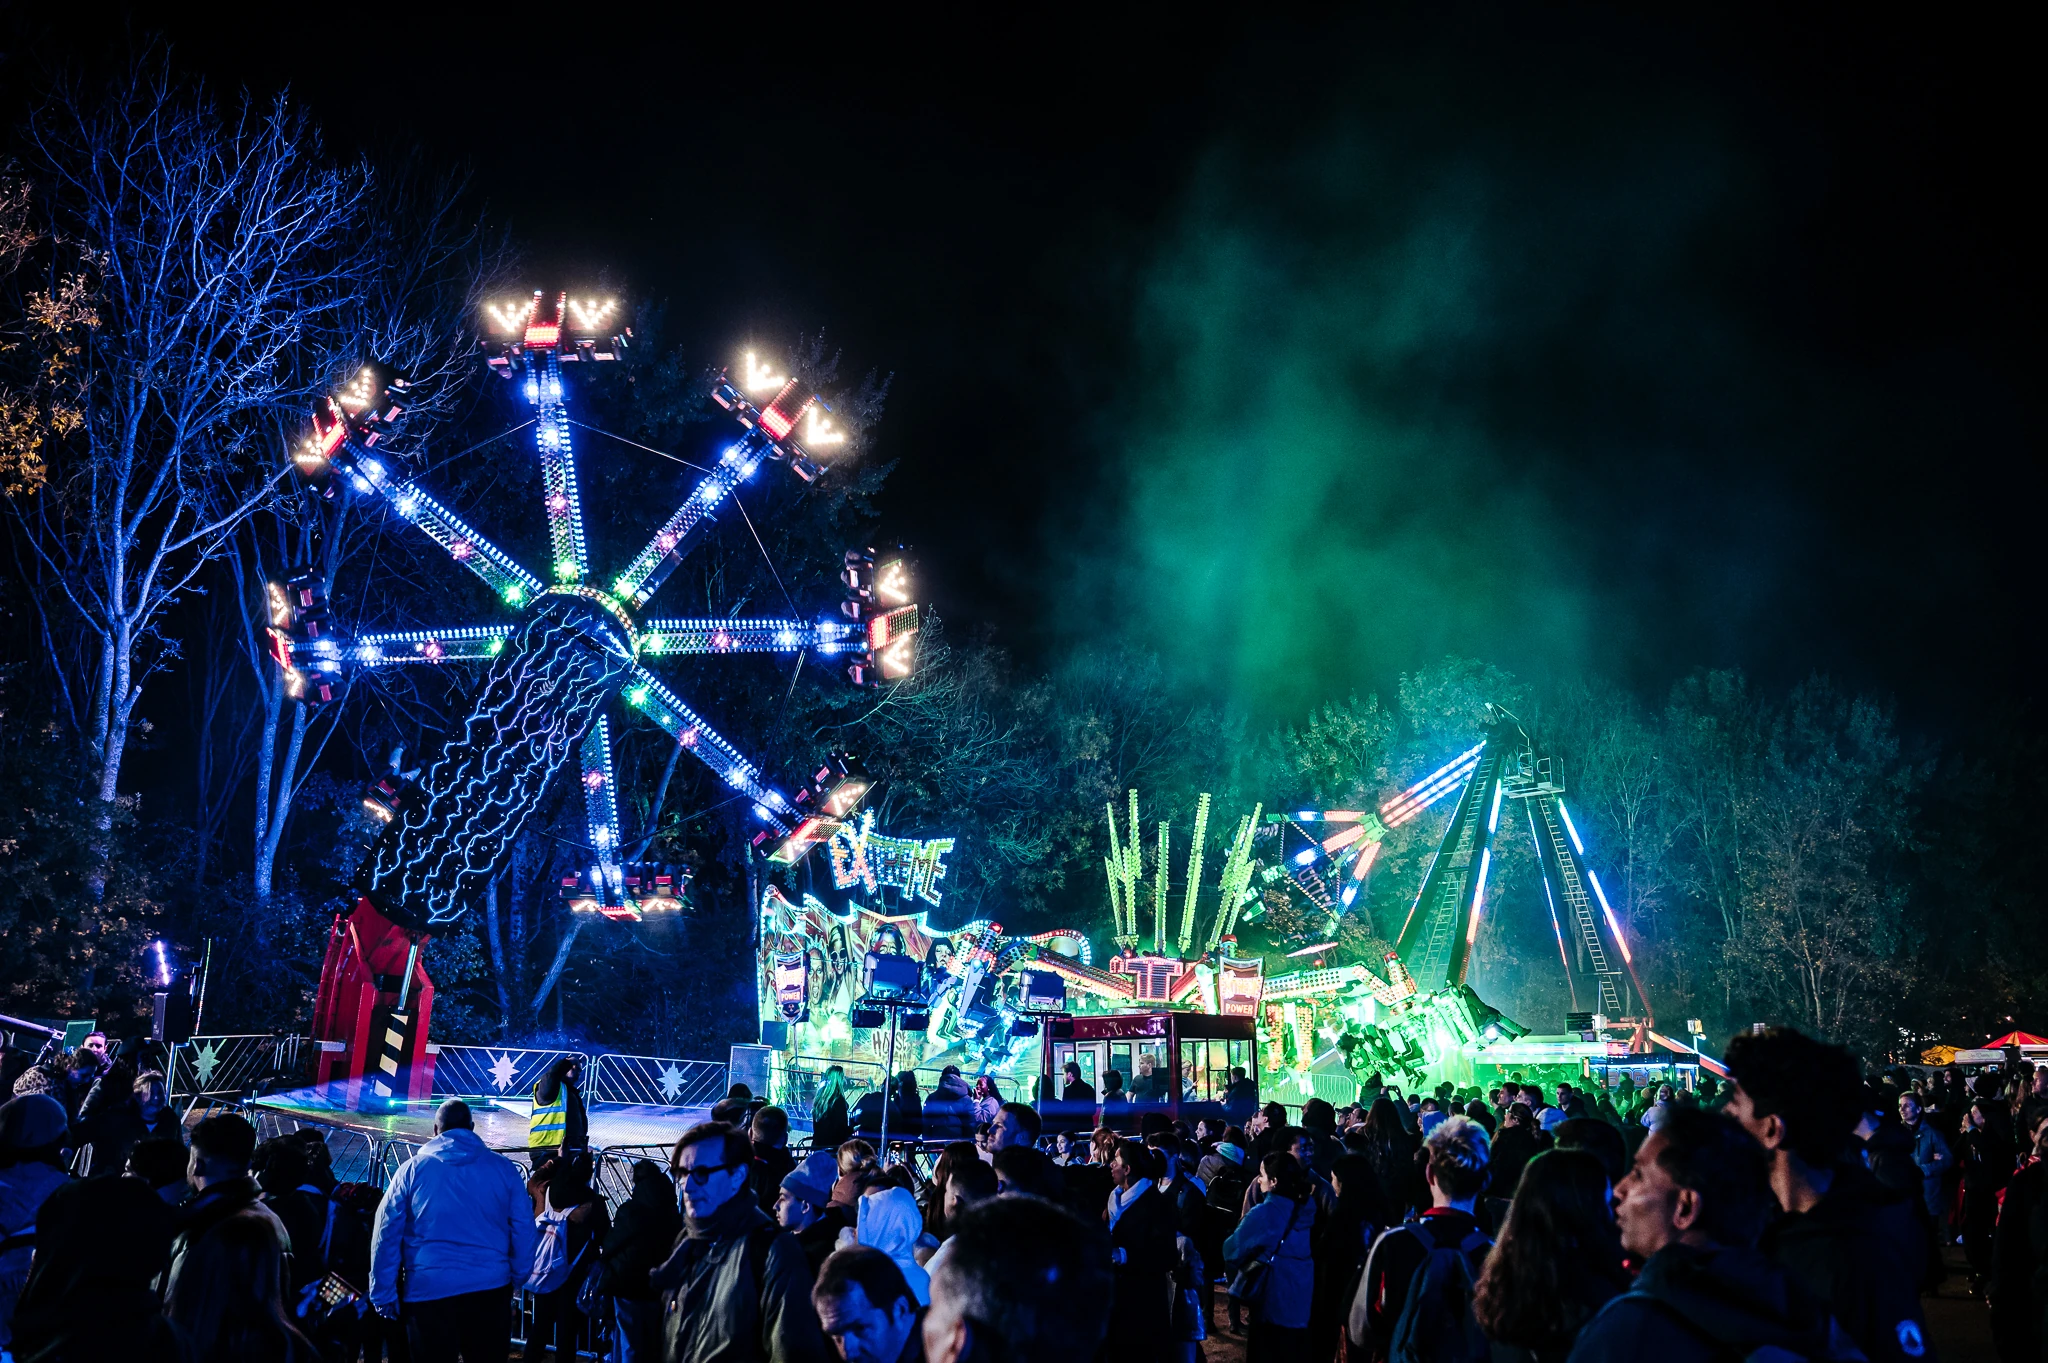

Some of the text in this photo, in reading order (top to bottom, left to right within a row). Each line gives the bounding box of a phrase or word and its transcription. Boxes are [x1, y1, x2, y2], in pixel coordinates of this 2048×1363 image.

[828, 806, 955, 907] EXTREME
[781, 991, 801, 1002] POWER
[1225, 1003, 1254, 1015] POWER
[872, 1030, 907, 1057] HOSE
